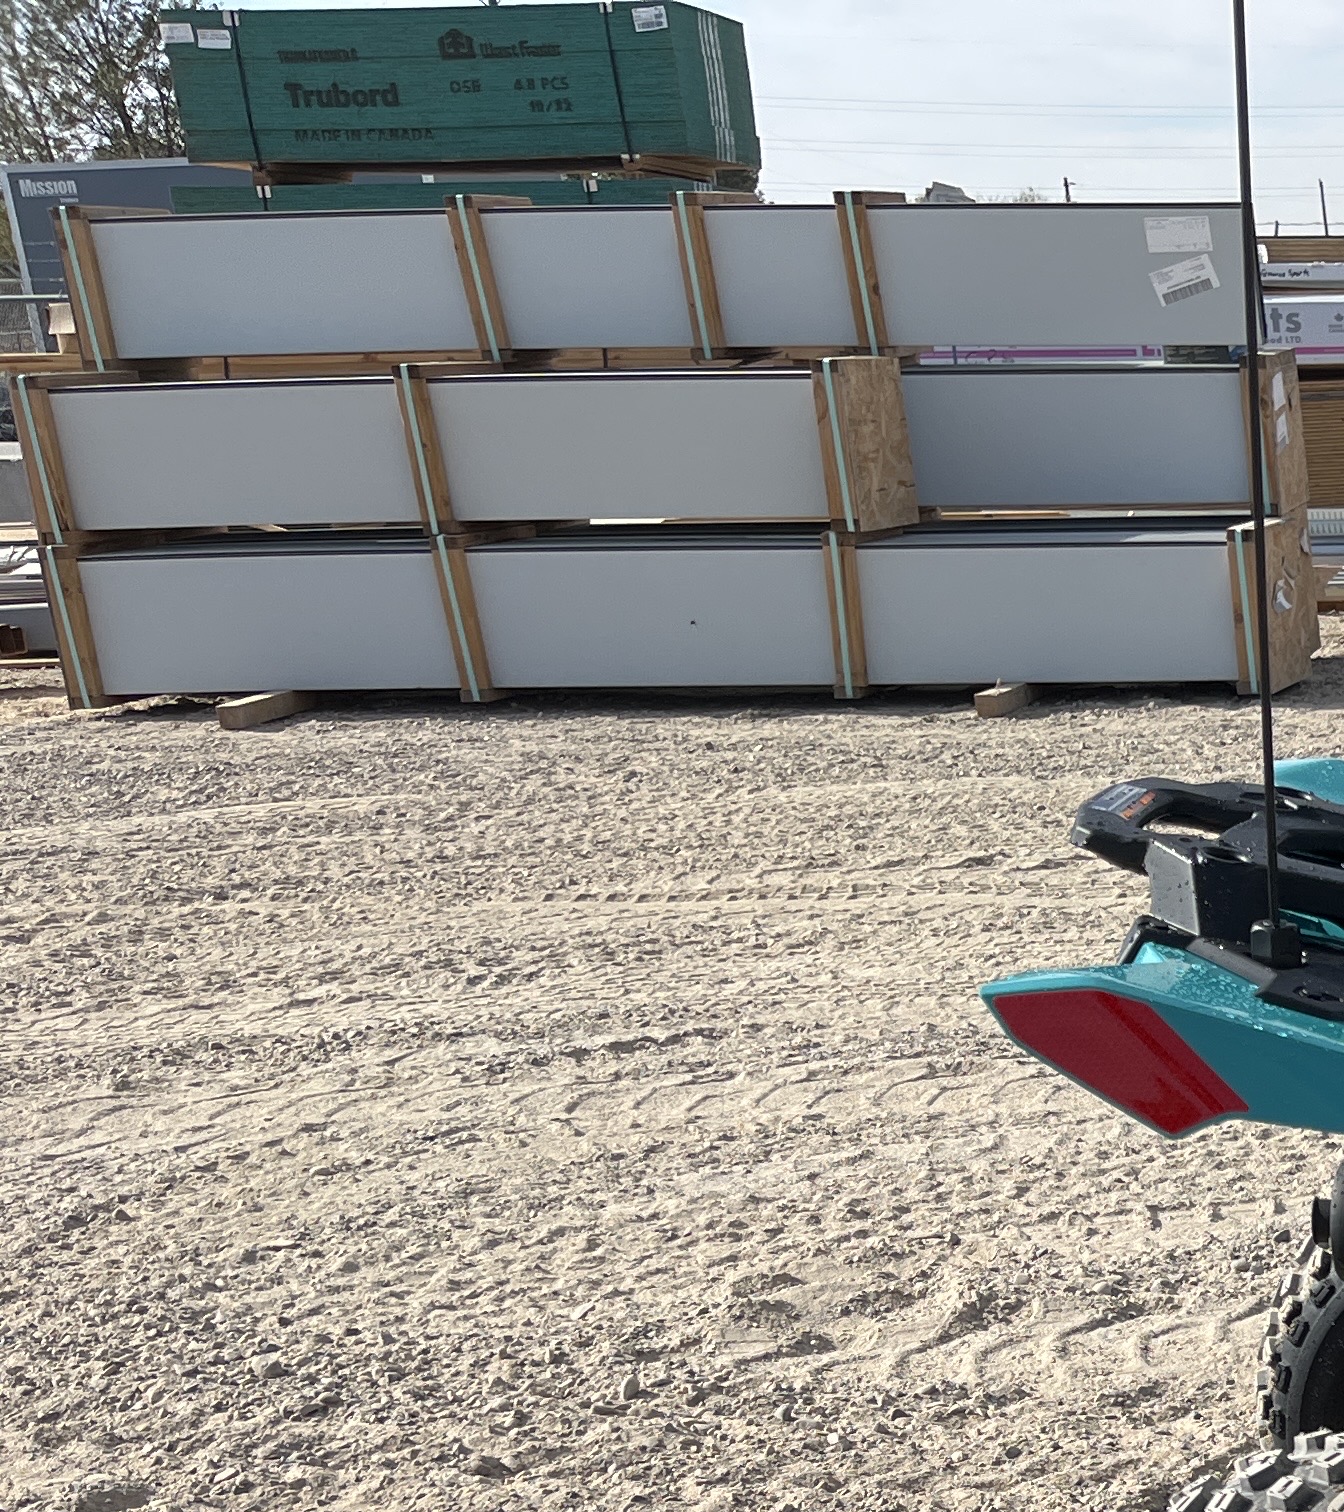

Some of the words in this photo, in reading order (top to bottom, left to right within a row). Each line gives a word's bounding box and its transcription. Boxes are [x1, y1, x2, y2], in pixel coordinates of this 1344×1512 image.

[450, 79, 481, 94] OSB
[541, 76, 569, 91] PCS
[283, 81, 401, 109] Trubord
[365, 127, 434, 142] CANADA
